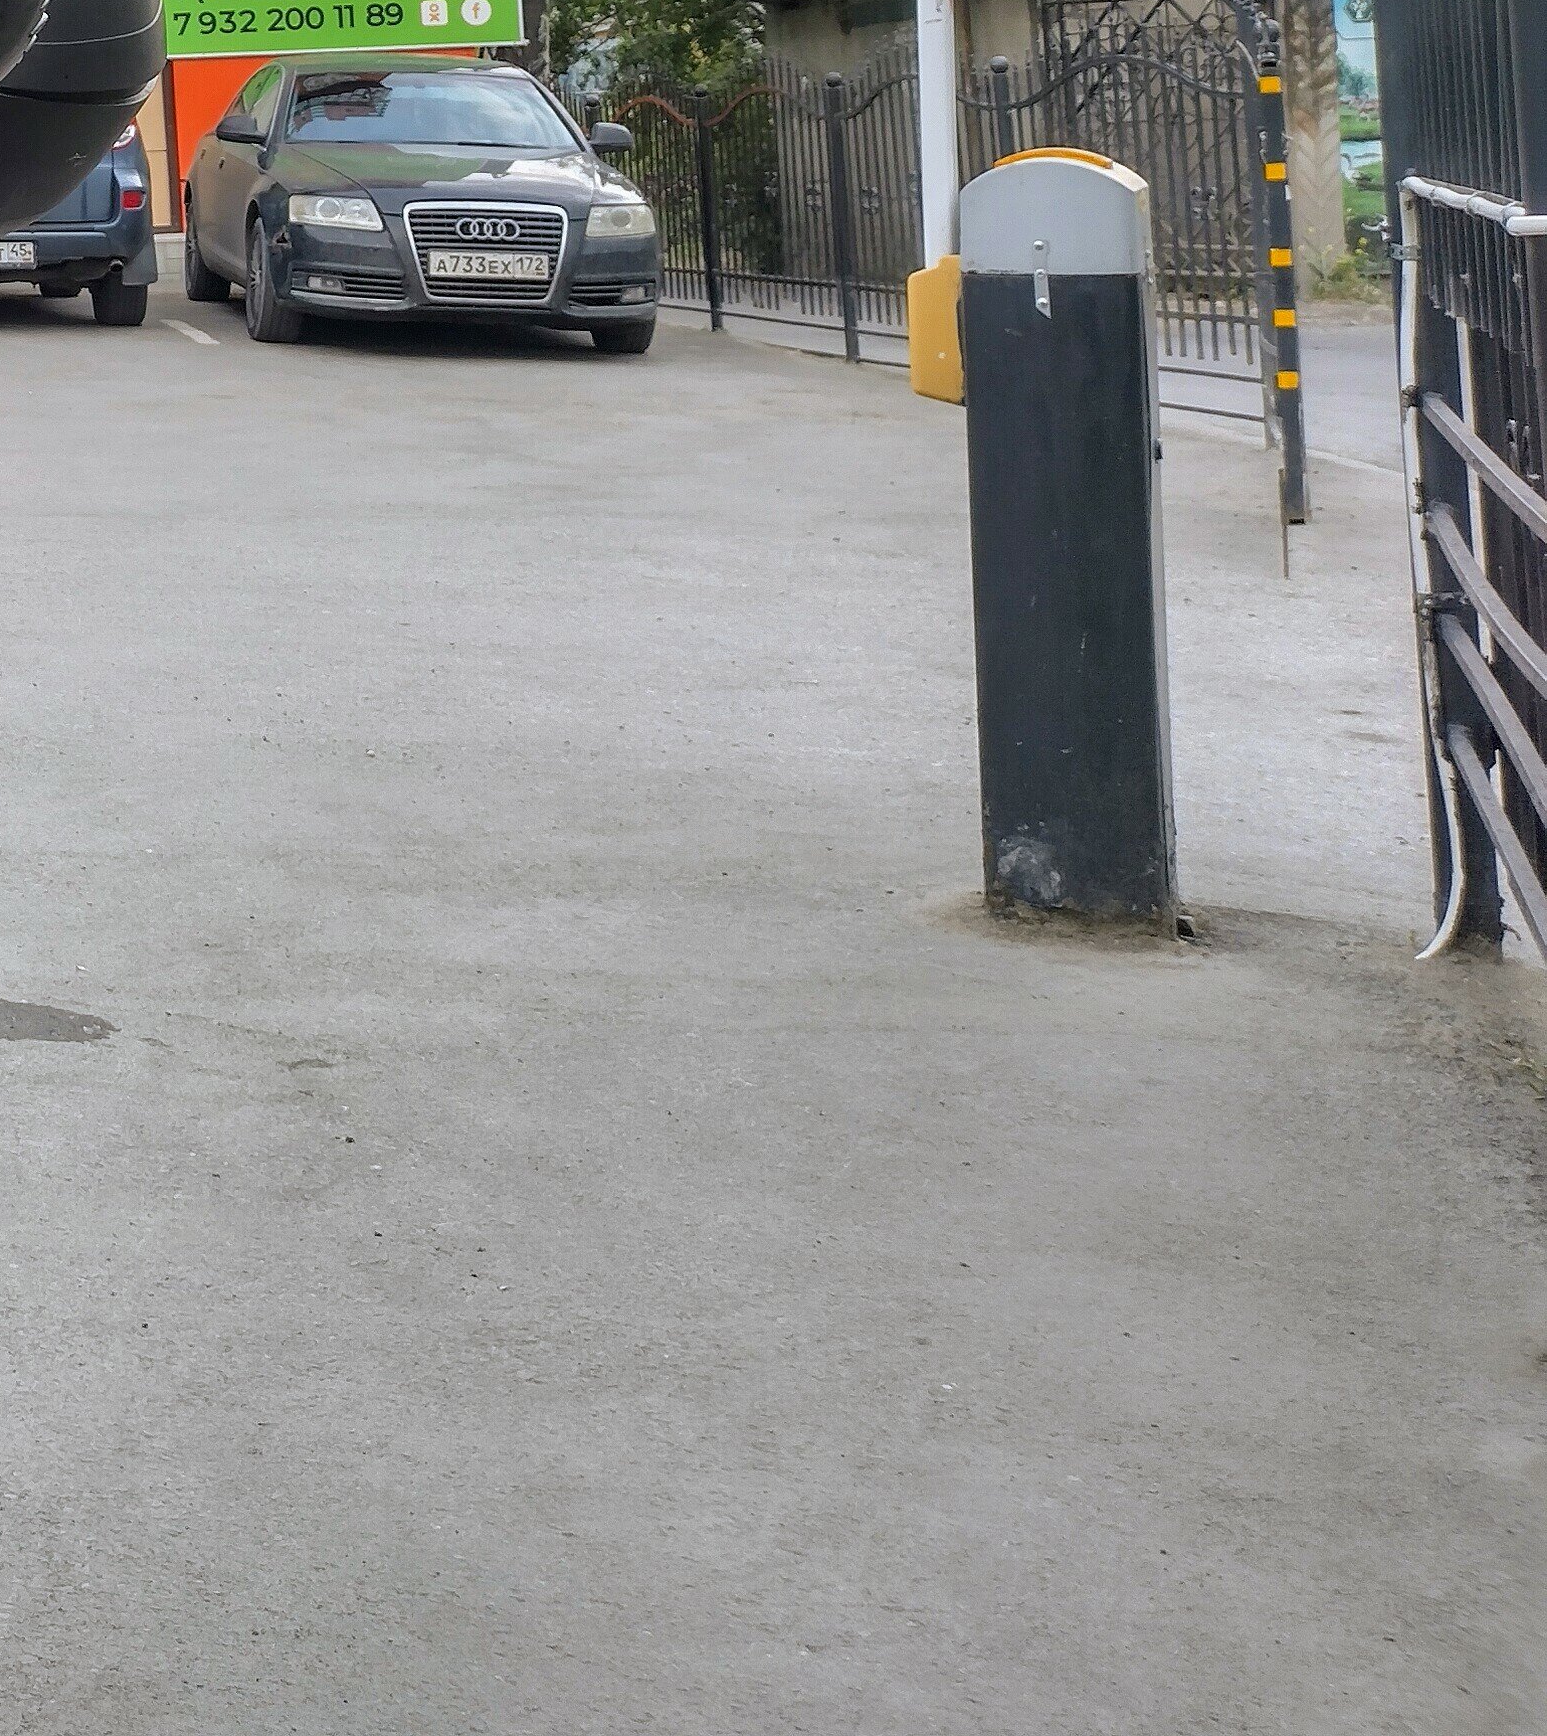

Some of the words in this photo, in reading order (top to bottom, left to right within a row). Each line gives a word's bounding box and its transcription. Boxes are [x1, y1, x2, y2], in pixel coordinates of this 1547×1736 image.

[198, 10, 258, 35] 932
[266, 6, 325, 32] 200
[332, 4, 356, 28] 11
[365, 2, 405, 27] 89
[436, 255, 512, 275] А733ЕХ
[516, 256, 544, 271] 172
